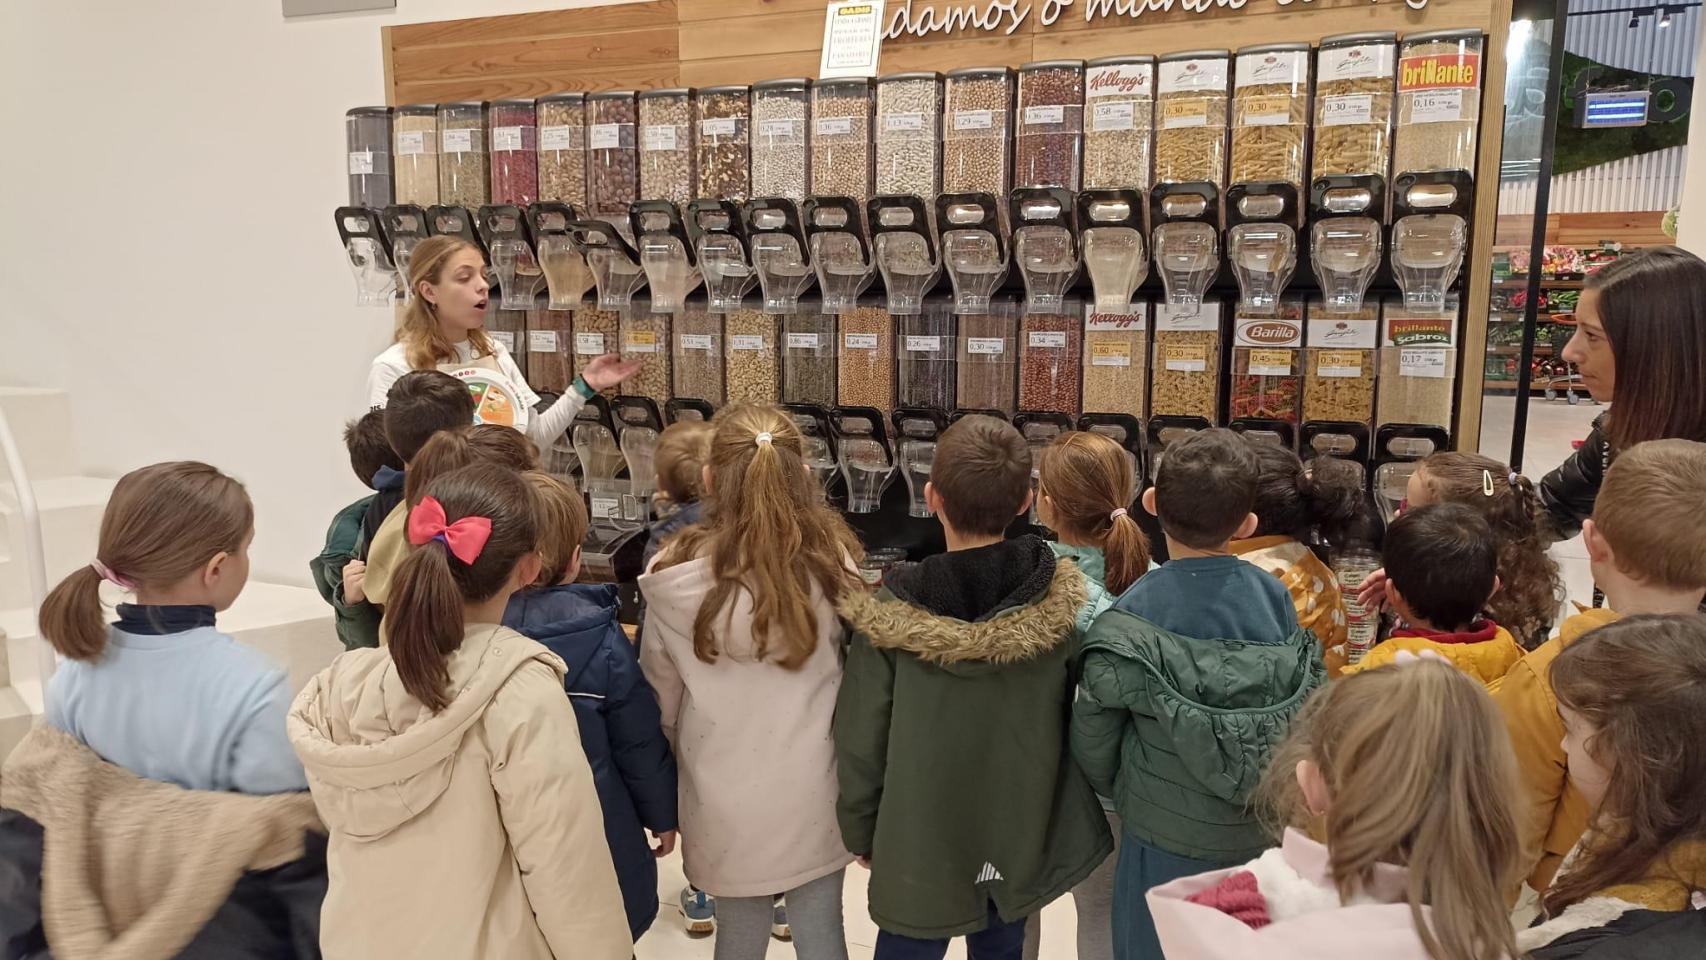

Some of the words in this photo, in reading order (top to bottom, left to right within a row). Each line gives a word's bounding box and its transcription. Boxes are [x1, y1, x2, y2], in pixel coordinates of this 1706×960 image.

[880, 0, 1031, 40] damos
[1402, 58, 1474, 87] brillante
[1090, 70, 1146, 92] Kellogg's
[1248, 102, 1267, 112] 0,30
[1326, 102, 1346, 113] 0,30
[1414, 98, 1435, 108] 0,16
[1250, 326, 1295, 339] Barilla
[1166, 349, 1184, 358] 0,30
[1252, 354, 1271, 363] 0,45
[1401, 355, 1421, 364] 0,17
